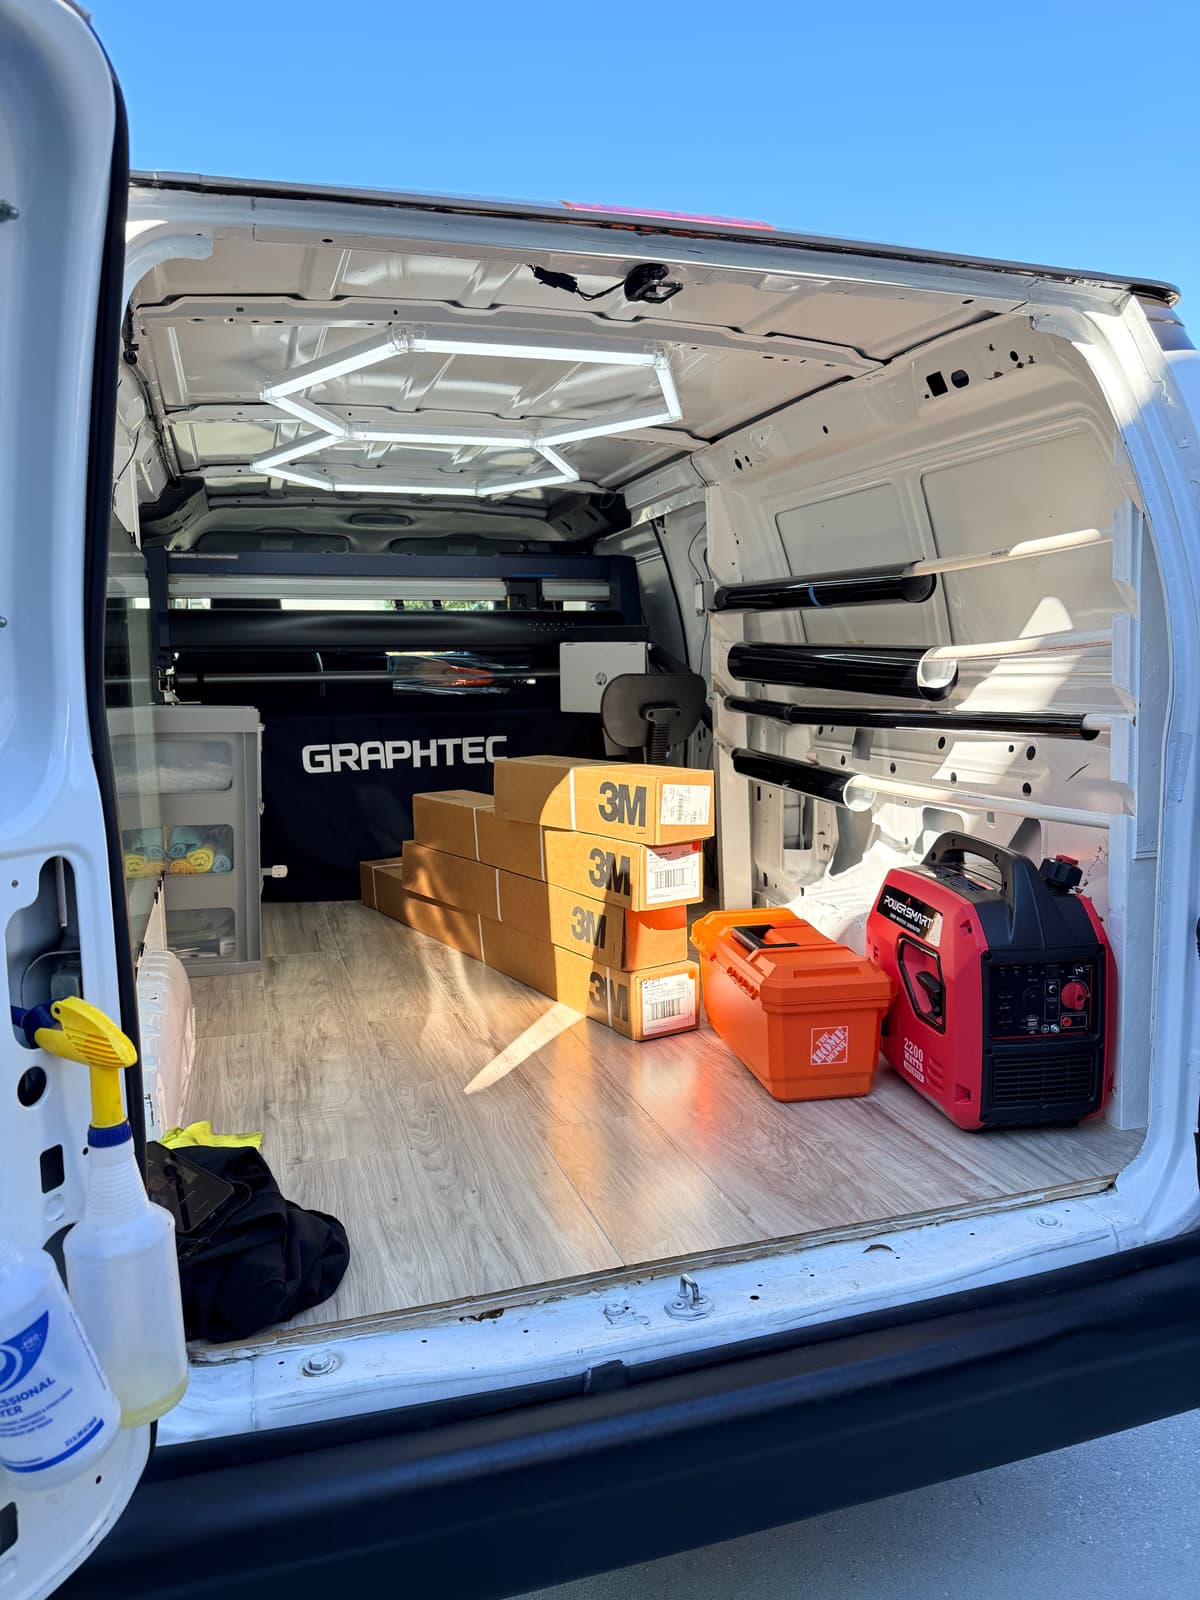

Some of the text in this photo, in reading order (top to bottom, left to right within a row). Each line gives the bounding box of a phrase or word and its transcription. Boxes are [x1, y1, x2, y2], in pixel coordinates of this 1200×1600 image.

[302, 735, 508, 774] GRAPHTEC
[598, 781, 647, 828] 3M
[588, 847, 631, 896] 3M
[571, 906, 607, 949] 3M
[589, 971, 629, 1023] 3M
[811, 1027, 848, 1064] HOME
[903, 1037, 924, 1063] 2200
[0, 1377, 56, 1408] SSIONAL
